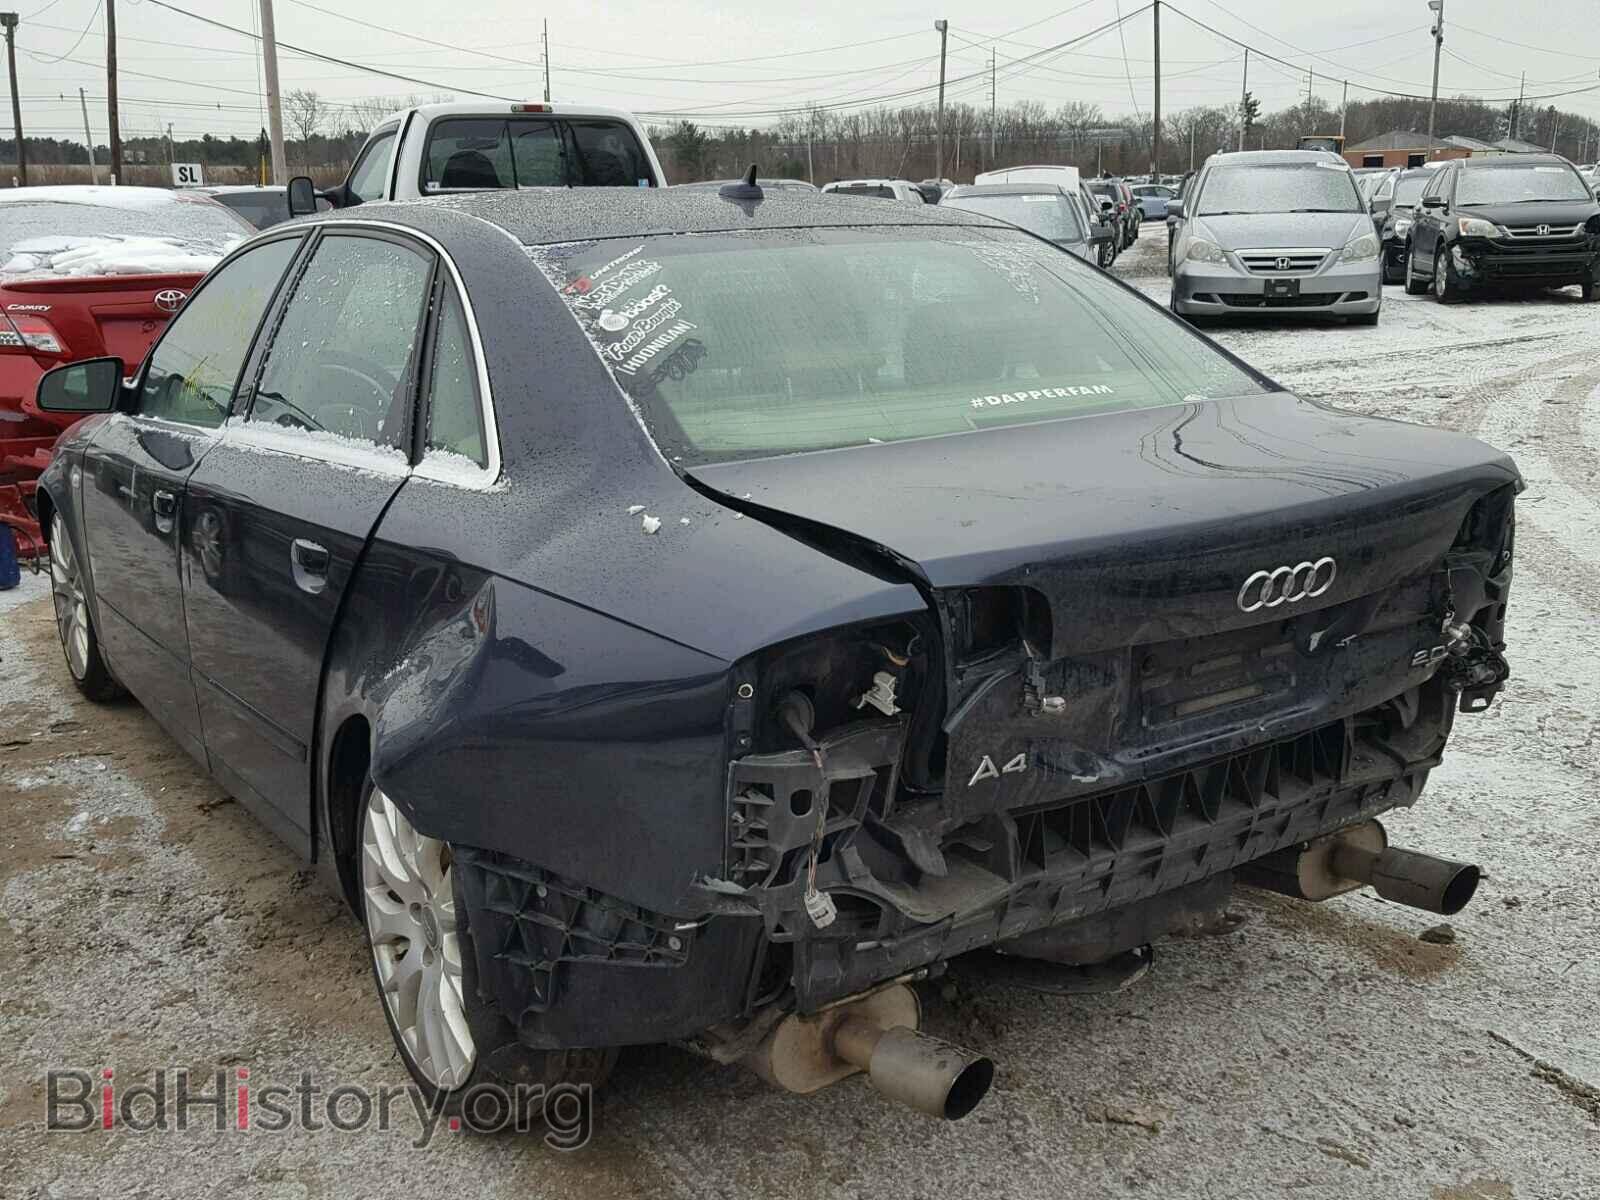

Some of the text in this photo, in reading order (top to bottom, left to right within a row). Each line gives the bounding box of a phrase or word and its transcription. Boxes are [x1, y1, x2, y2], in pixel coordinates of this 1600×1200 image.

[178, 166, 198, 183] SL
[970, 384, 1114, 409] #DAPPERFAM
[967, 752, 1027, 786] A4
